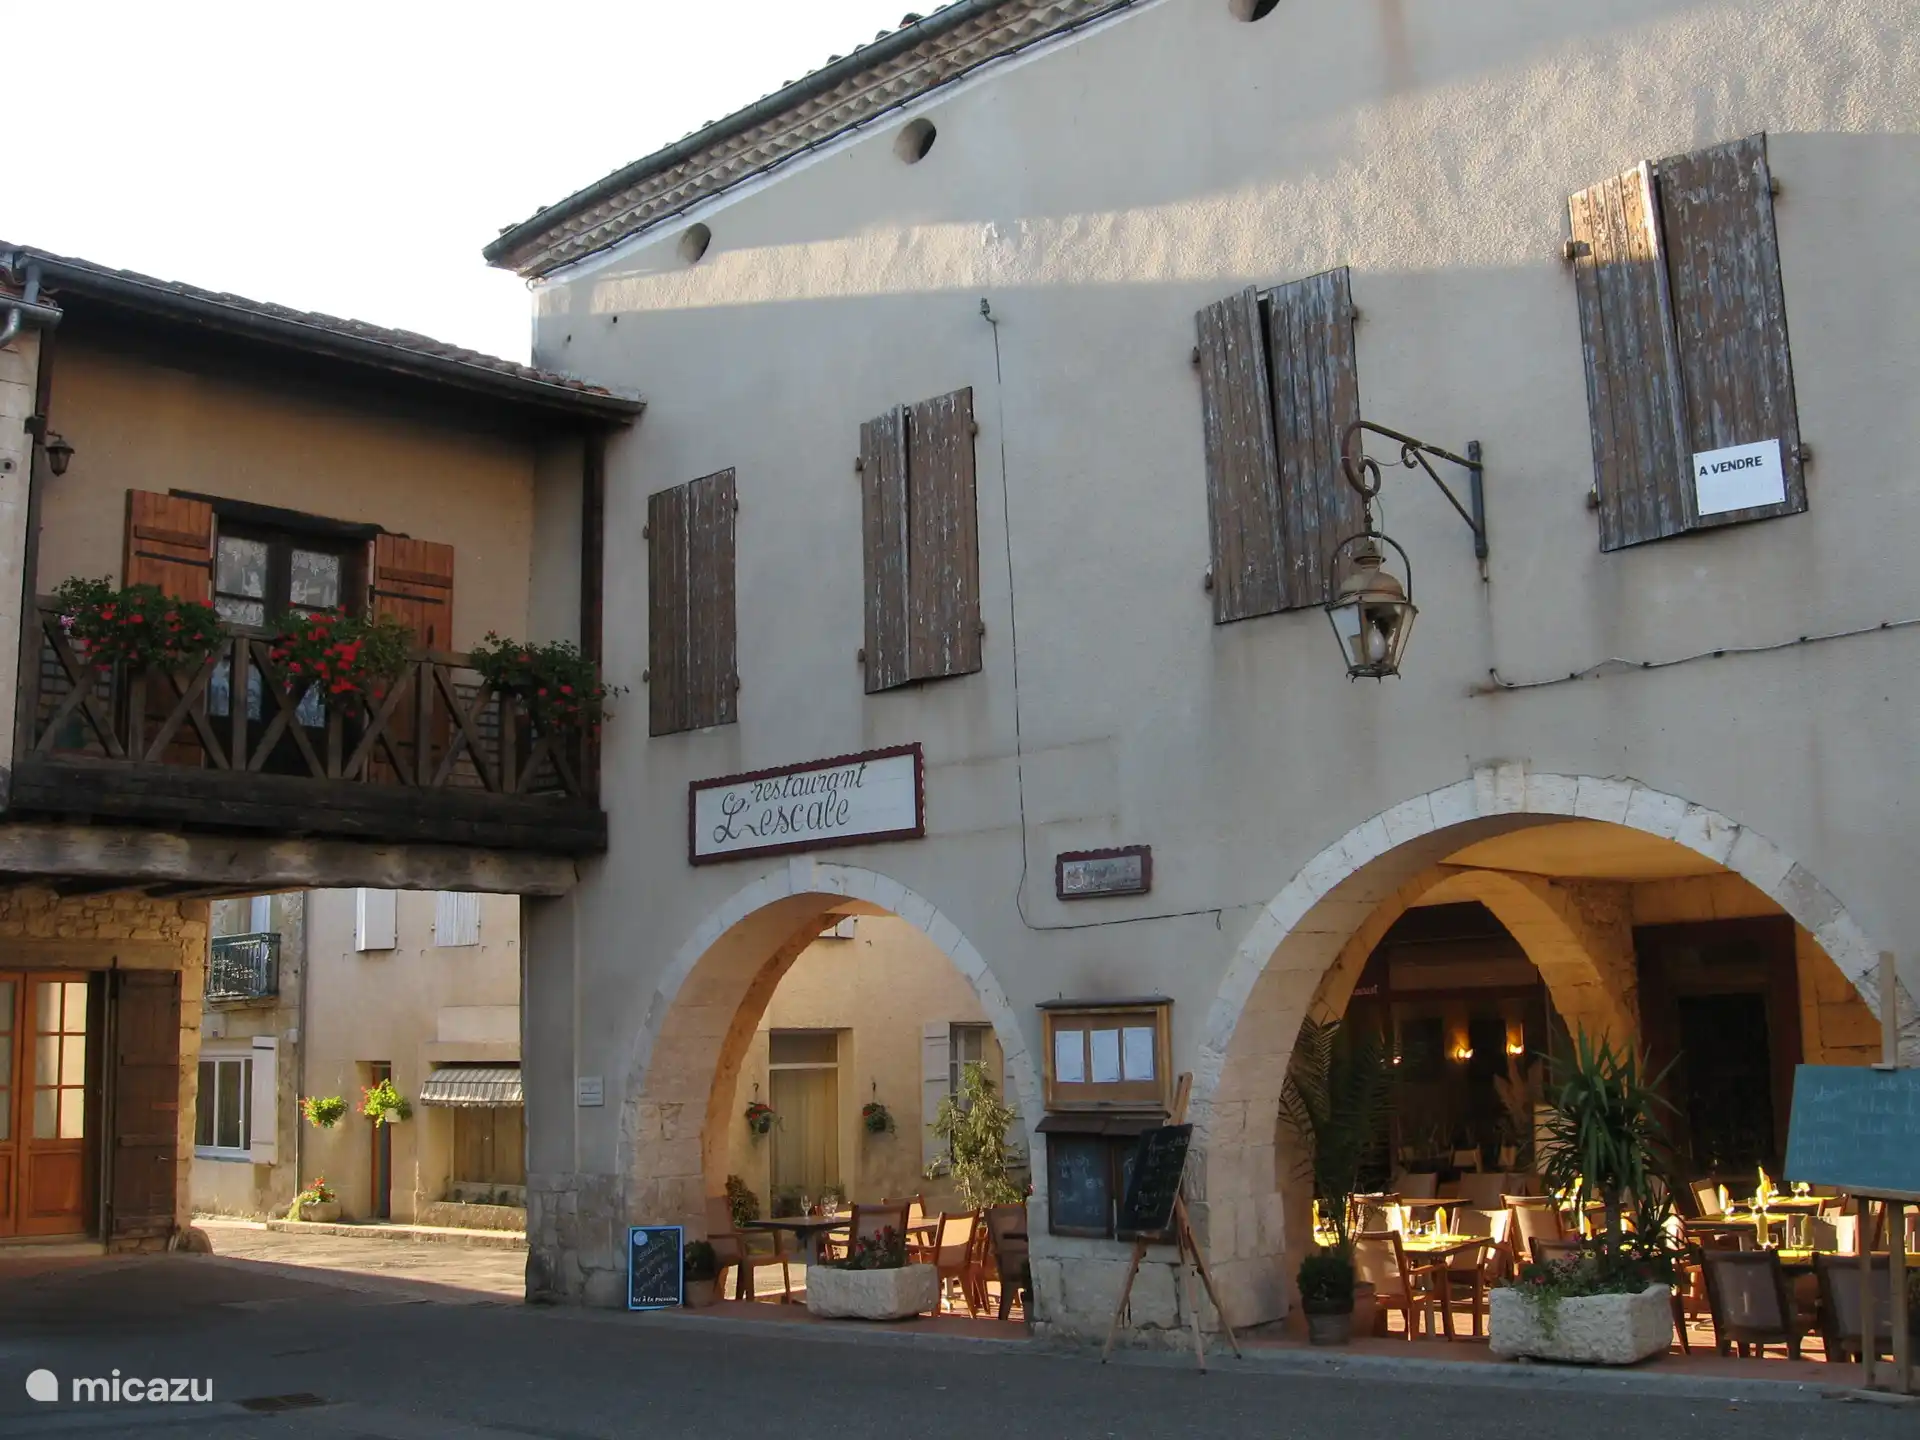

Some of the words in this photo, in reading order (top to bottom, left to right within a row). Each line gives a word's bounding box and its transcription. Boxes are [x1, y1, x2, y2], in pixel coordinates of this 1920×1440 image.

[1699, 465, 1708, 476] A
[1711, 456, 1763, 474] VENDRE
[750, 761, 867, 803] restaurant
